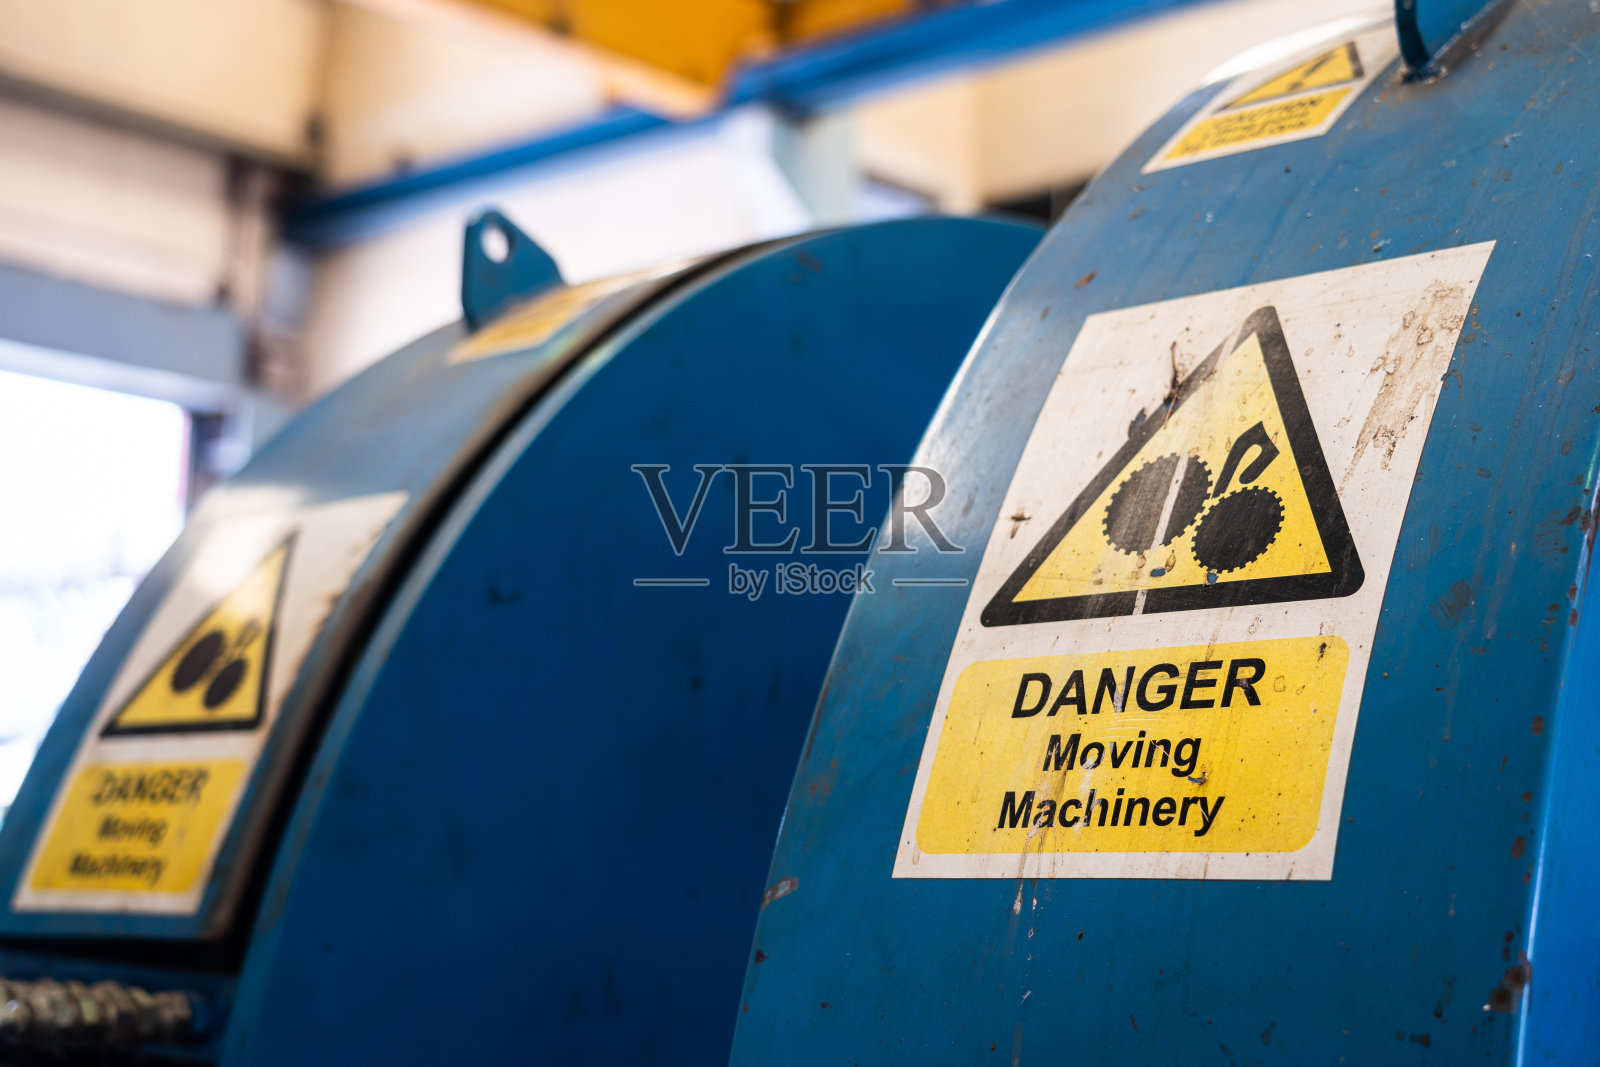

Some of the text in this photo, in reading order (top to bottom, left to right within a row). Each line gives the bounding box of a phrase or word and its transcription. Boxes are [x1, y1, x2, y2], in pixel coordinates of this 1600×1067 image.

[1011, 657, 1267, 719] DANGER
[1042, 730, 1202, 778] Moving
[92, 768, 209, 805] DANGER
[97, 815, 168, 847] Moving
[998, 788, 1226, 837] Machinery
